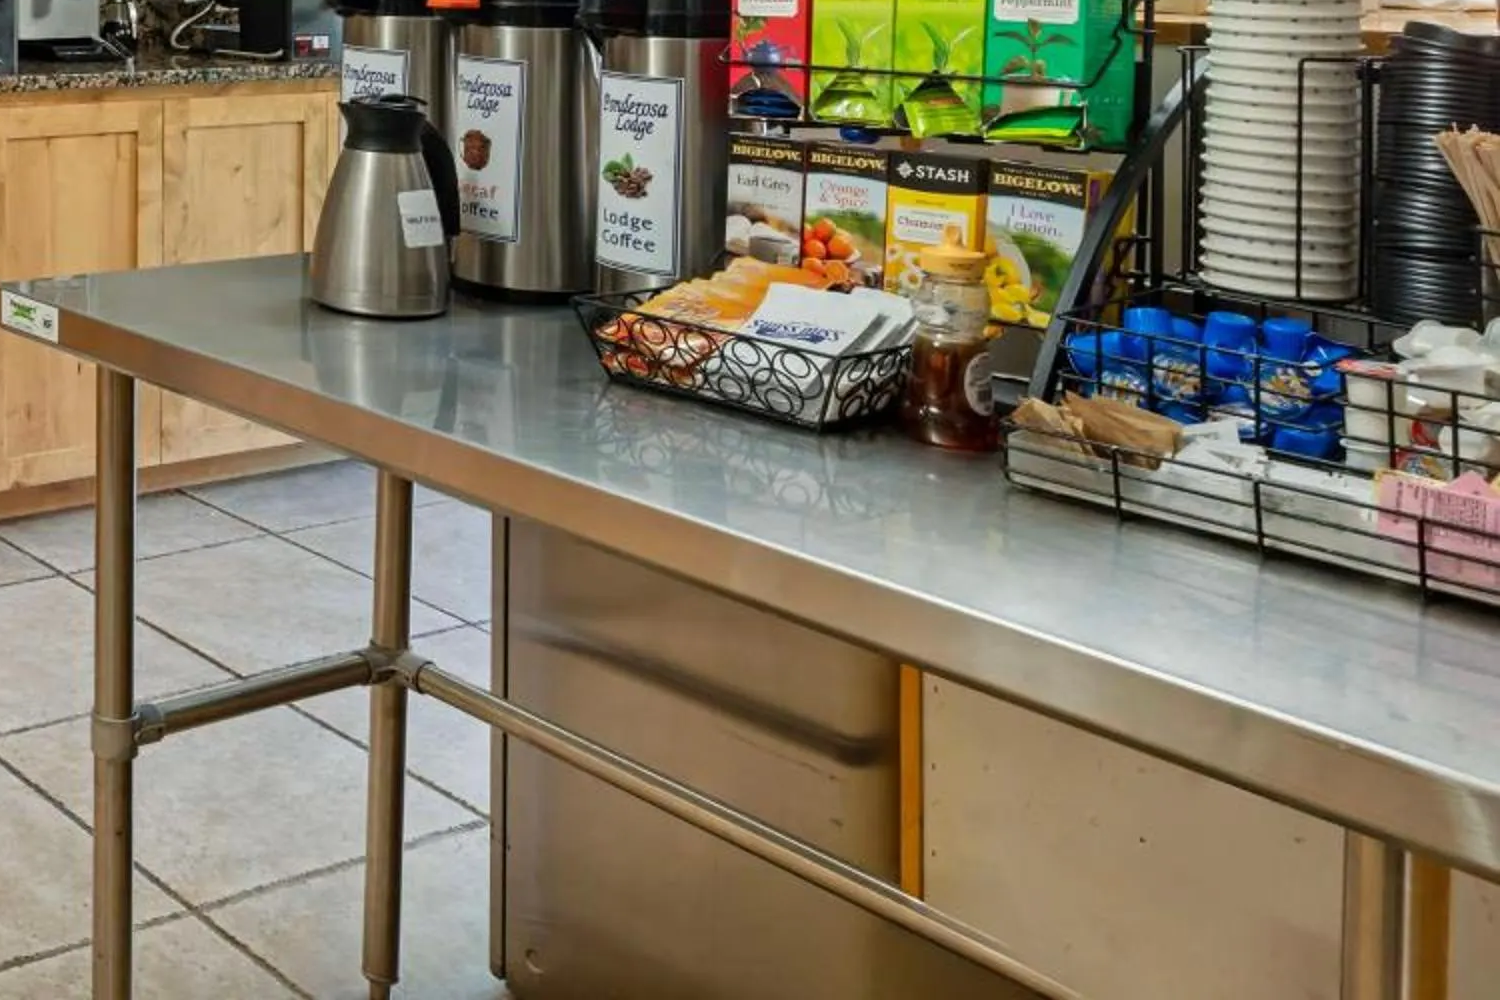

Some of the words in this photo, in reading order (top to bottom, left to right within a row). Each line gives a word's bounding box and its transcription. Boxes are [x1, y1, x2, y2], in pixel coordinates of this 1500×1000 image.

[467, 95, 500, 119] Lodge
[615, 116, 655, 141] Lodge
[915, 164, 970, 183] STASH
[737, 174, 759, 187] Earl
[761, 175, 792, 194] Grey
[819, 180, 869, 196] Orange
[461, 201, 499, 220] offee
[833, 194, 868, 210] Spice
[603, 207, 654, 231] Lodge
[1019, 204, 1055, 221] Love
[602, 228, 657, 254] Coffee
